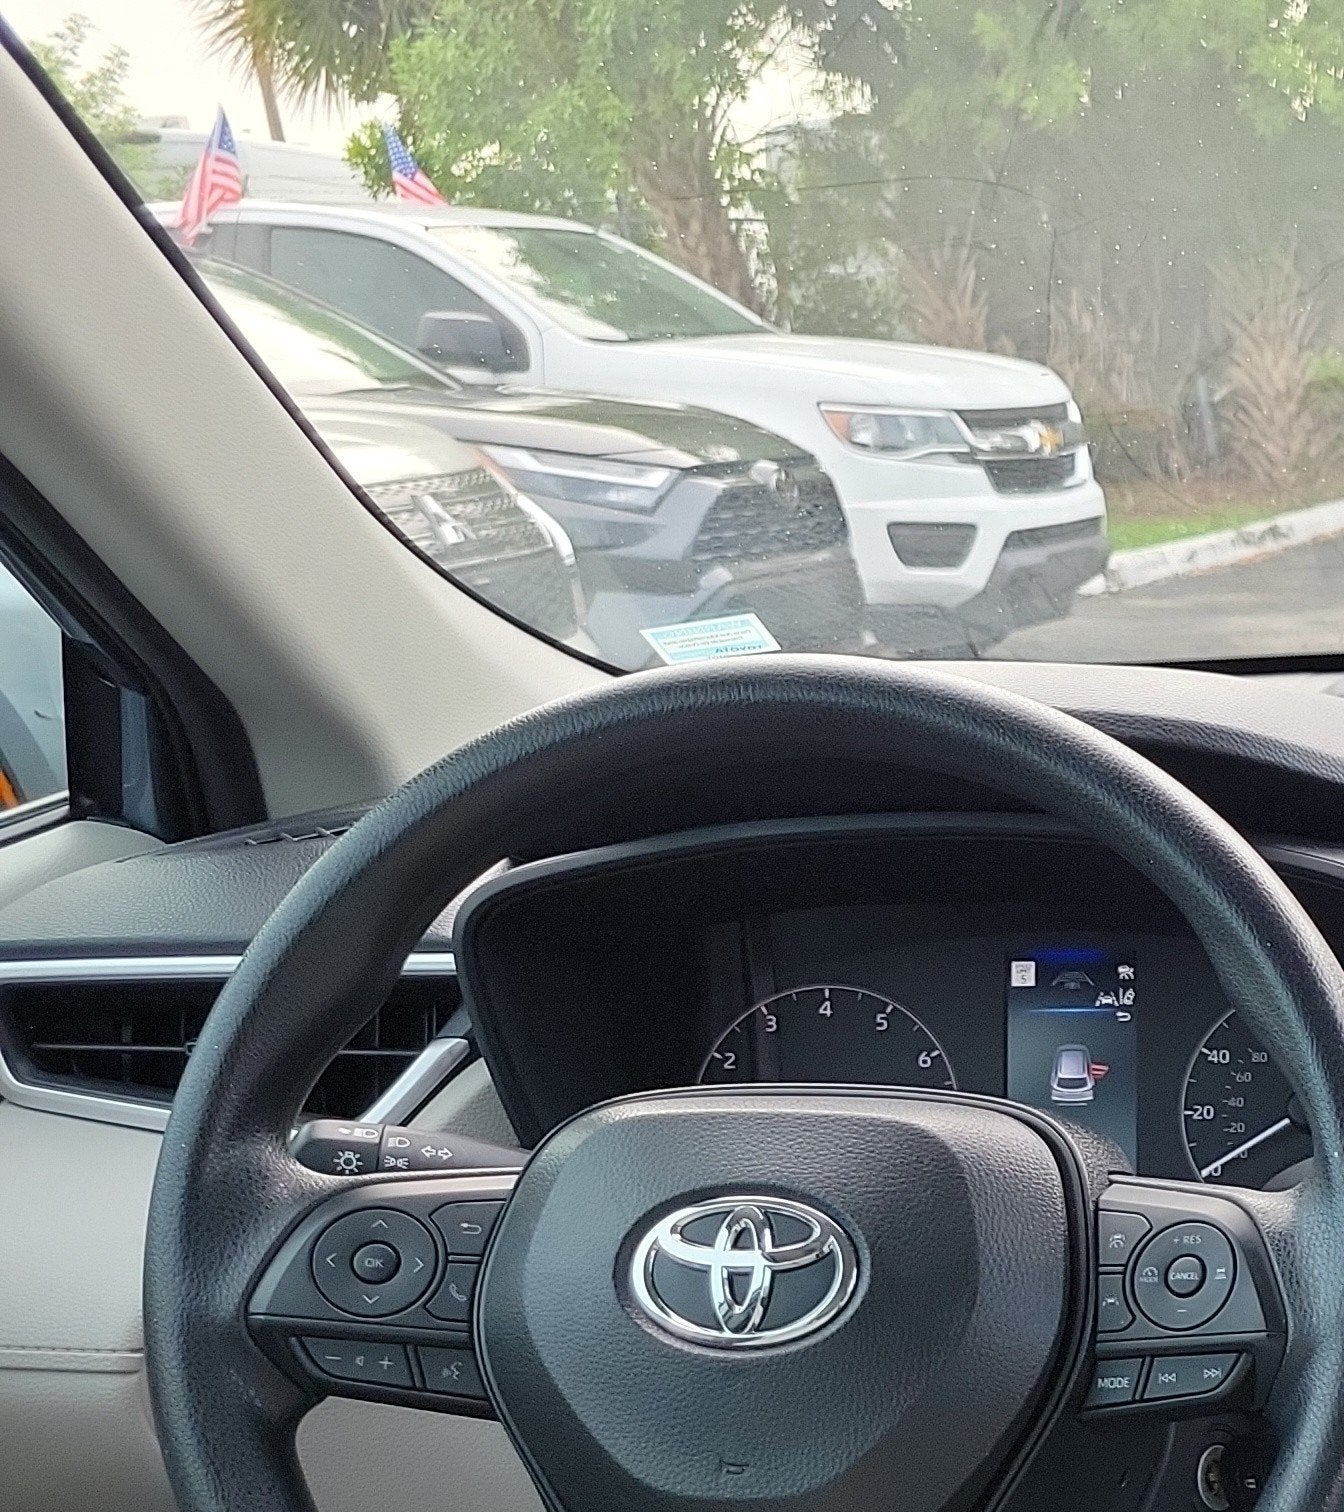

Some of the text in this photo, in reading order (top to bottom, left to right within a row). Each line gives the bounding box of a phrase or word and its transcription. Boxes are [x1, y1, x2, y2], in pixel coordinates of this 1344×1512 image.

[819, 1000, 833, 1018] 4
[765, 1014, 778, 1033] 3
[875, 1013, 889, 1031] 5
[723, 1052, 737, 1070] 2
[917, 1051, 932, 1068] 6
[1208, 1049, 1230, 1064] 40
[1251, 1051, 1269, 1063] 80
[1236, 1072, 1252, 1083] 60
[1228, 1096, 1245, 1108] 40
[1192, 1105, 1215, 1120] 20
[1229, 1122, 1246, 1134] 20
[1183, 1235, 1202, 1245] RES
[364, 1258, 384, 1268] OK
[1170, 1271, 1200, 1281] CANCEL
[1097, 1377, 1131, 1389] MODE
